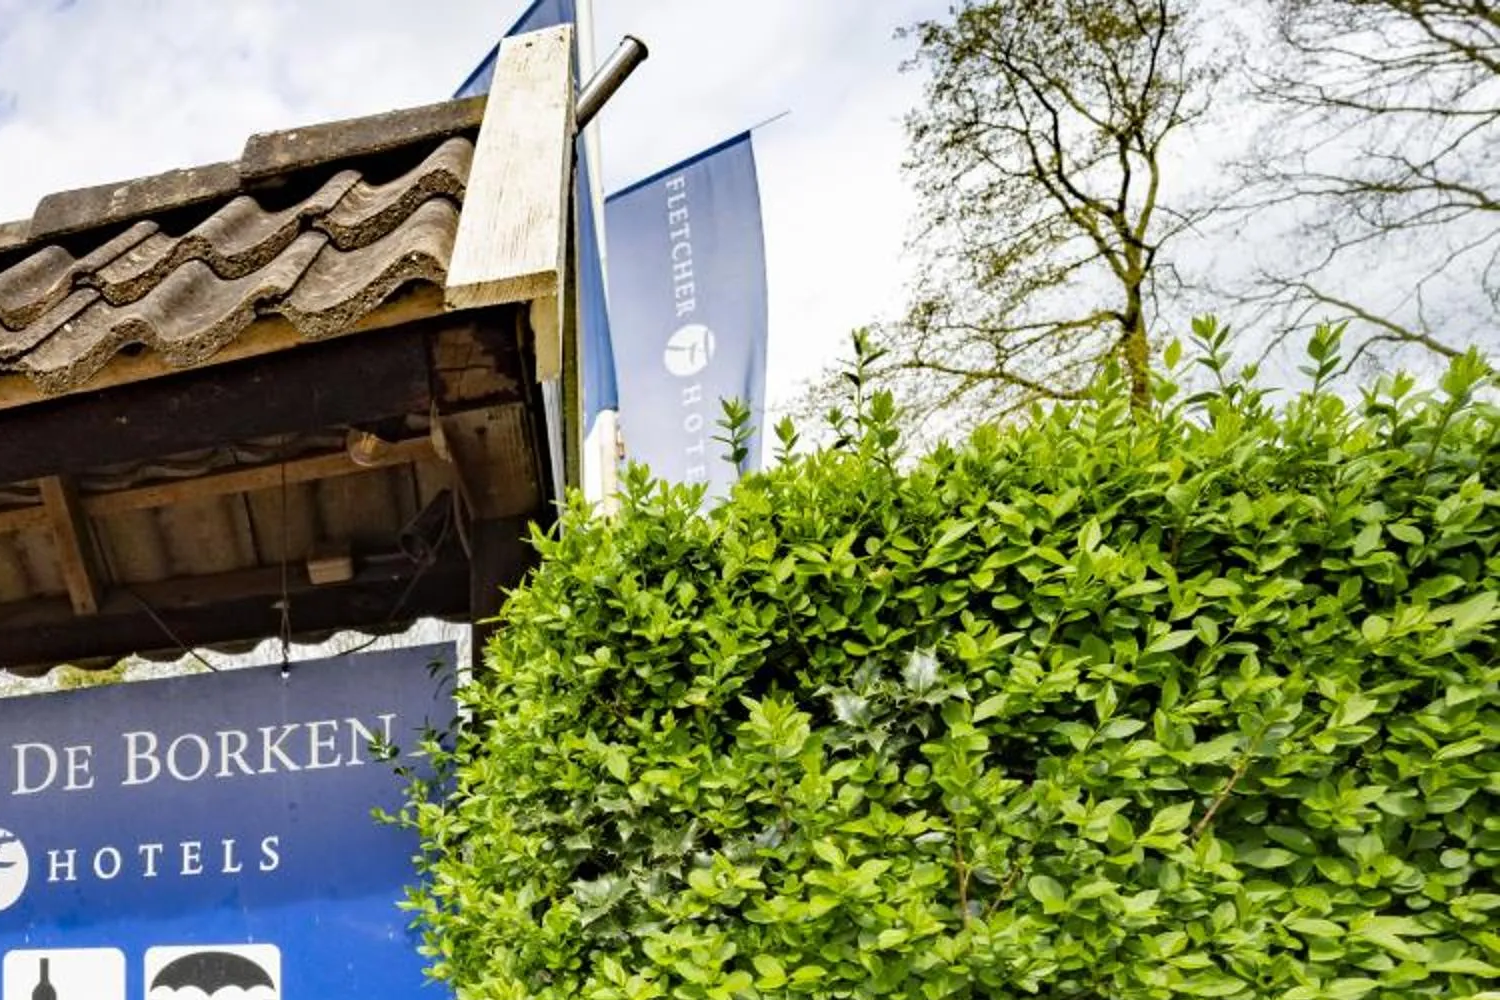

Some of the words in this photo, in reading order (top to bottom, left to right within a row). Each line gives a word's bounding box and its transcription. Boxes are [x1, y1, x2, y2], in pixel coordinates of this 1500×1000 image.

[665, 175, 696, 318] FLETCHER
[682, 384, 706, 483] HOTE
[122, 713, 397, 785] BORKEN
[48, 836, 280, 881] HOTELS
